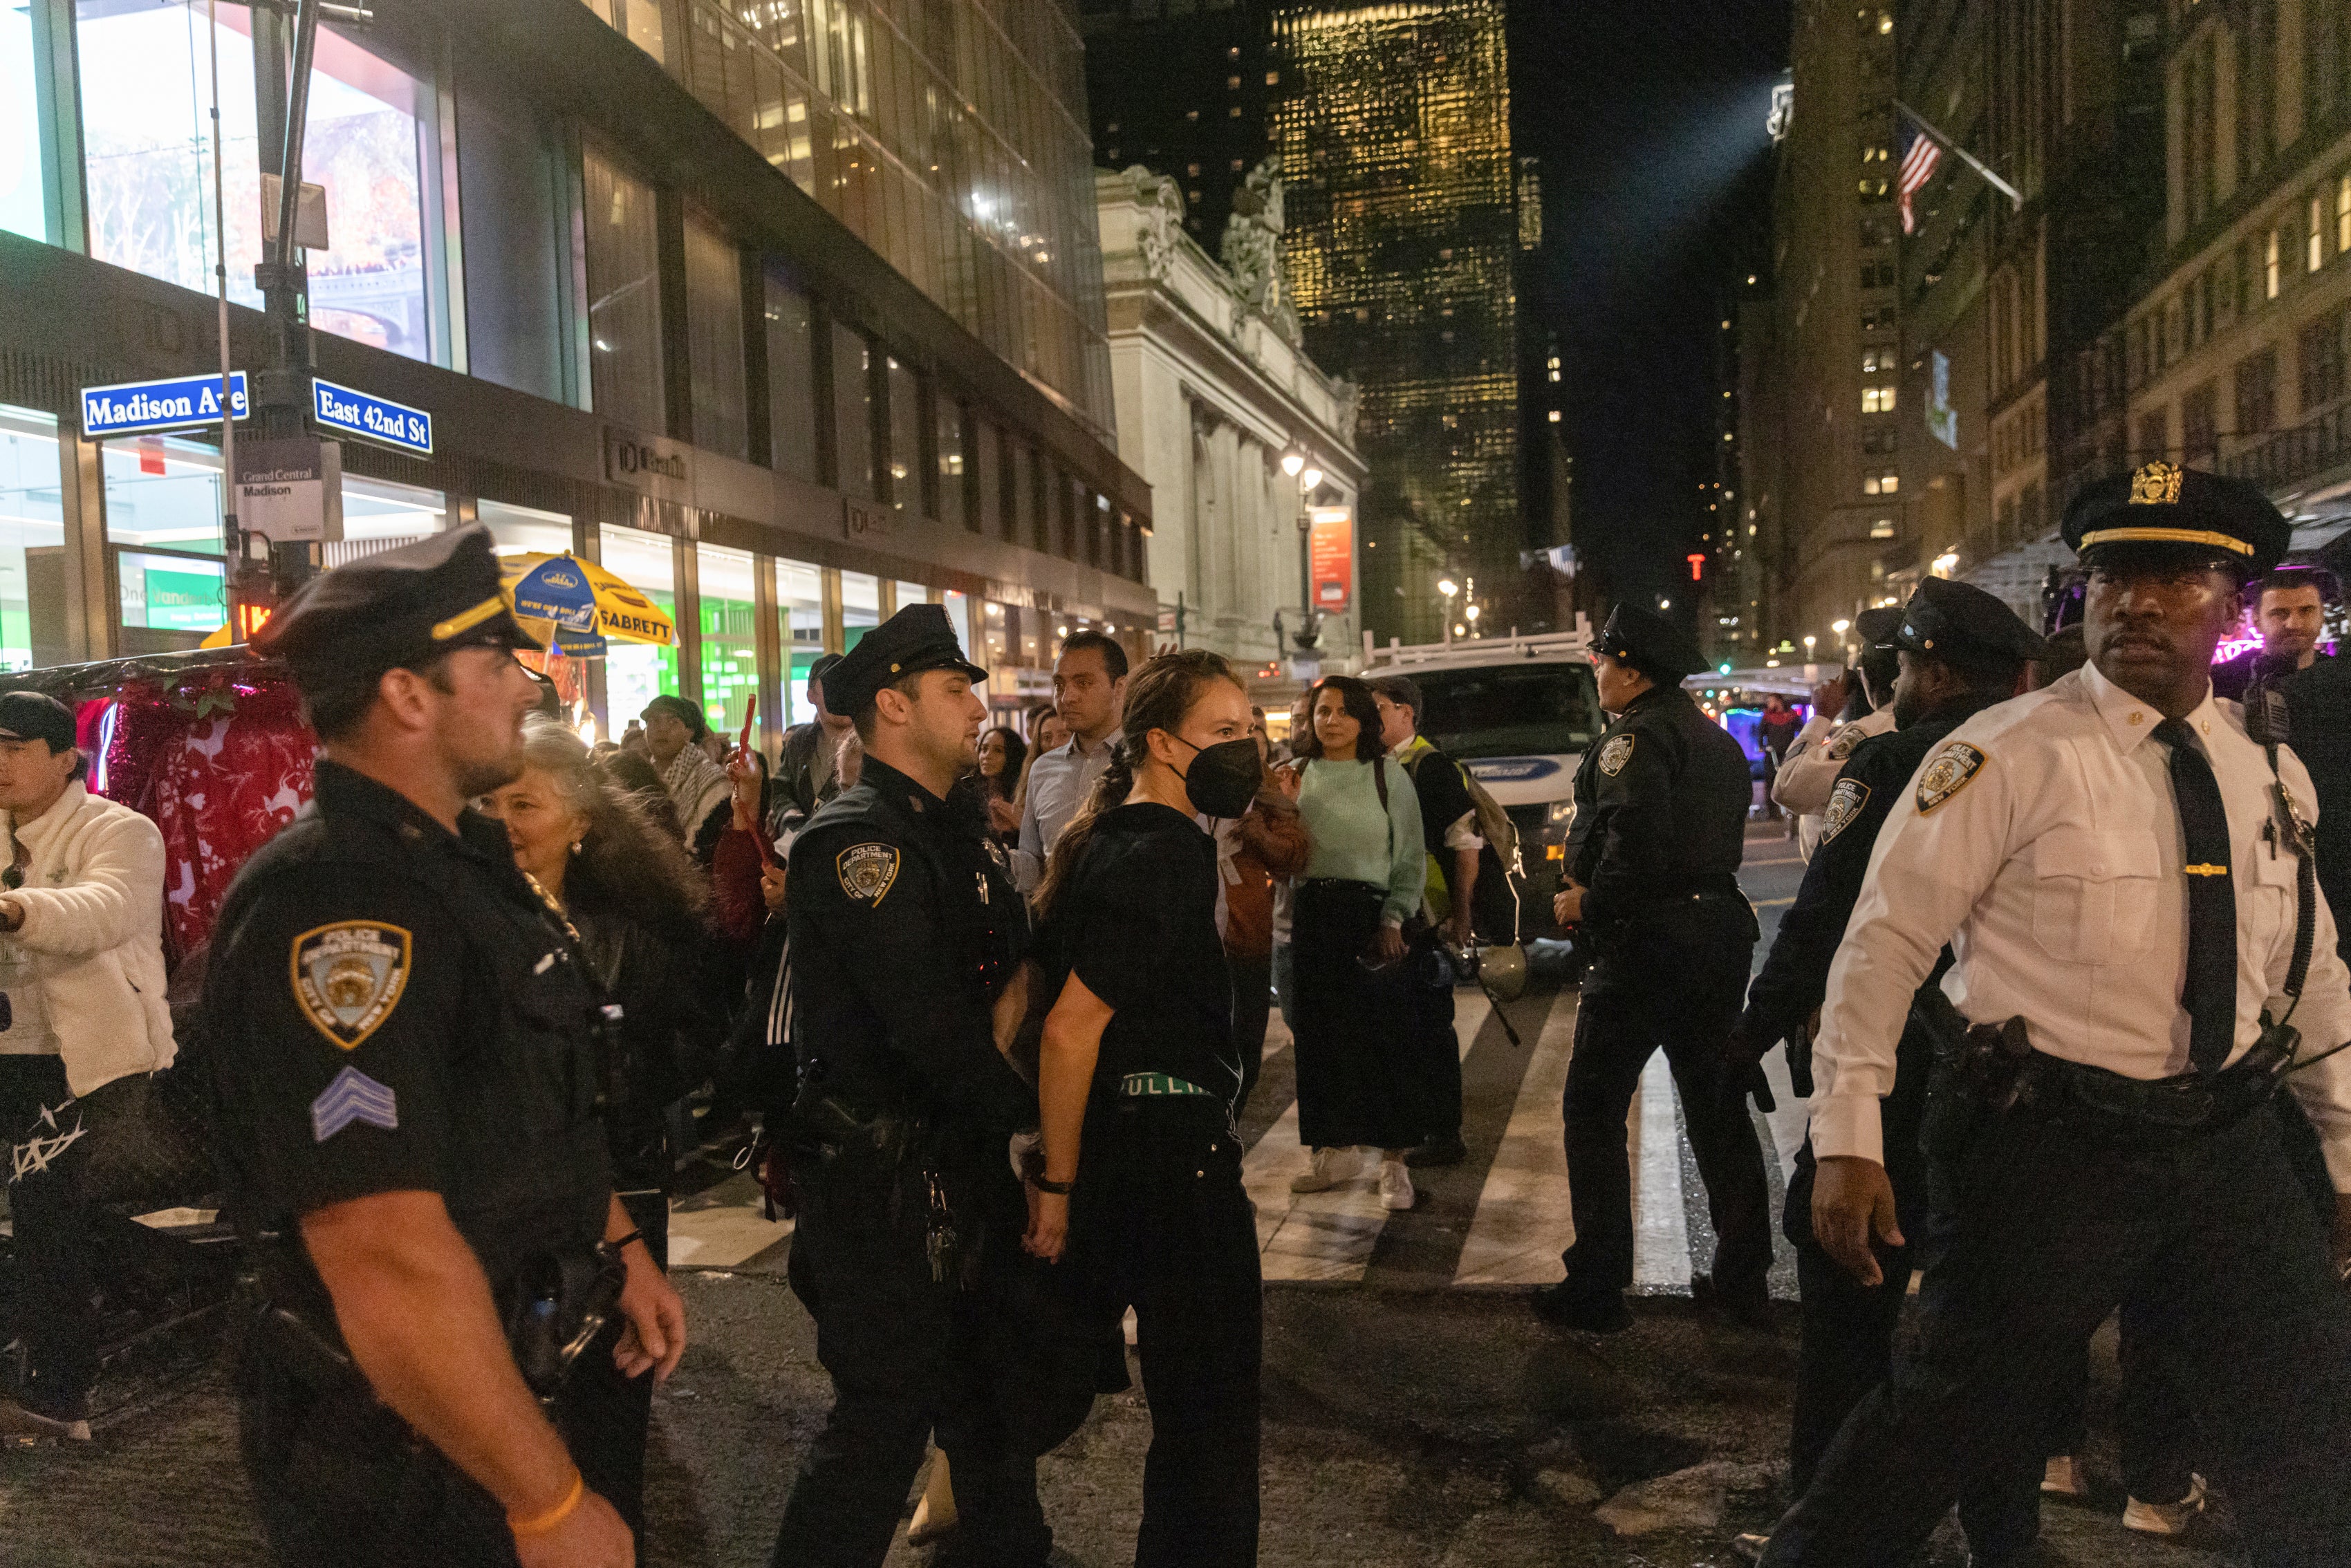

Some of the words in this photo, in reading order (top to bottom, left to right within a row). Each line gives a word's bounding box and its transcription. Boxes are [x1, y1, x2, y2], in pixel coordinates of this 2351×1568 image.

[87, 393, 192, 426] Madison
[319, 389, 361, 426] East
[363, 404, 406, 439] 42nd
[408, 416, 427, 445] St
[243, 470, 274, 483] Grand
[275, 467, 312, 481] Central
[243, 485, 292, 496] Madison
[600, 610, 669, 638] SABRETT
[1841, 807, 1859, 825] YORK
[851, 845, 882, 857] POLICE
[843, 852, 893, 871] DEPARTMENT
[844, 877, 856, 892] CITY
[854, 890, 864, 899] OF
[873, 881, 887, 898] NEW
[884, 862, 895, 881] YORK
[1121, 1076, 1204, 1096] ULLI
